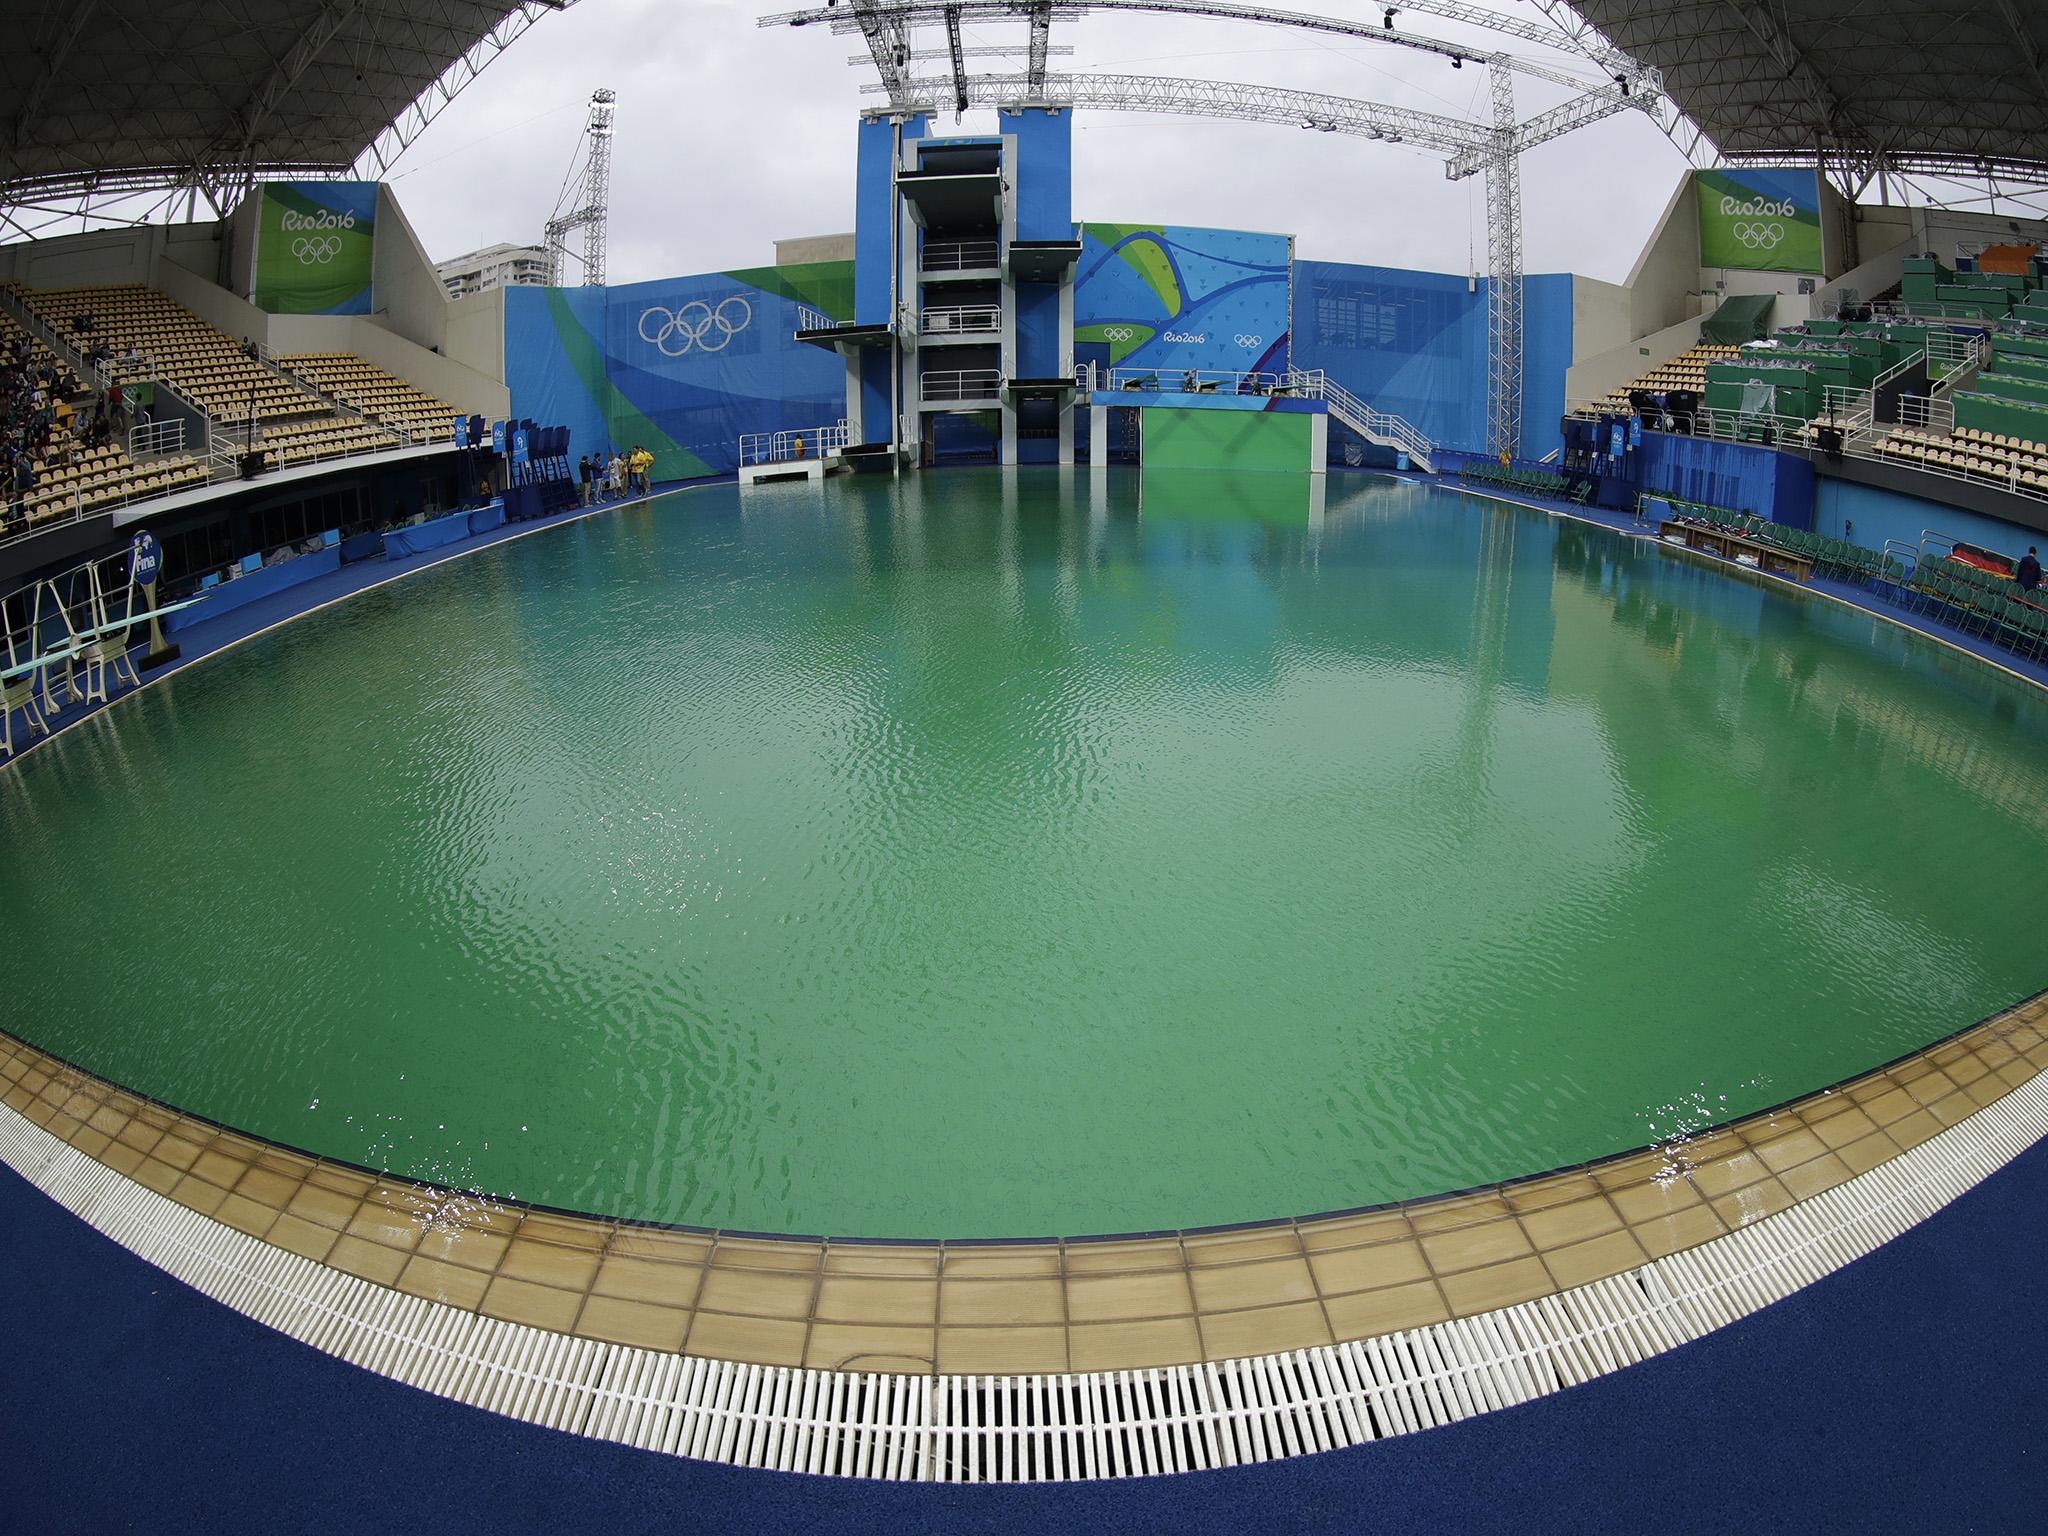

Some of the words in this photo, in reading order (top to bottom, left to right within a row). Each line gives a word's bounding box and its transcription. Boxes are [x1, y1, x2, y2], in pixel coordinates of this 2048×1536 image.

[1720, 196, 1795, 217] Rio2016
[281, 208, 355, 231] Rio2016
[1163, 331, 1205, 344] Rio2016
